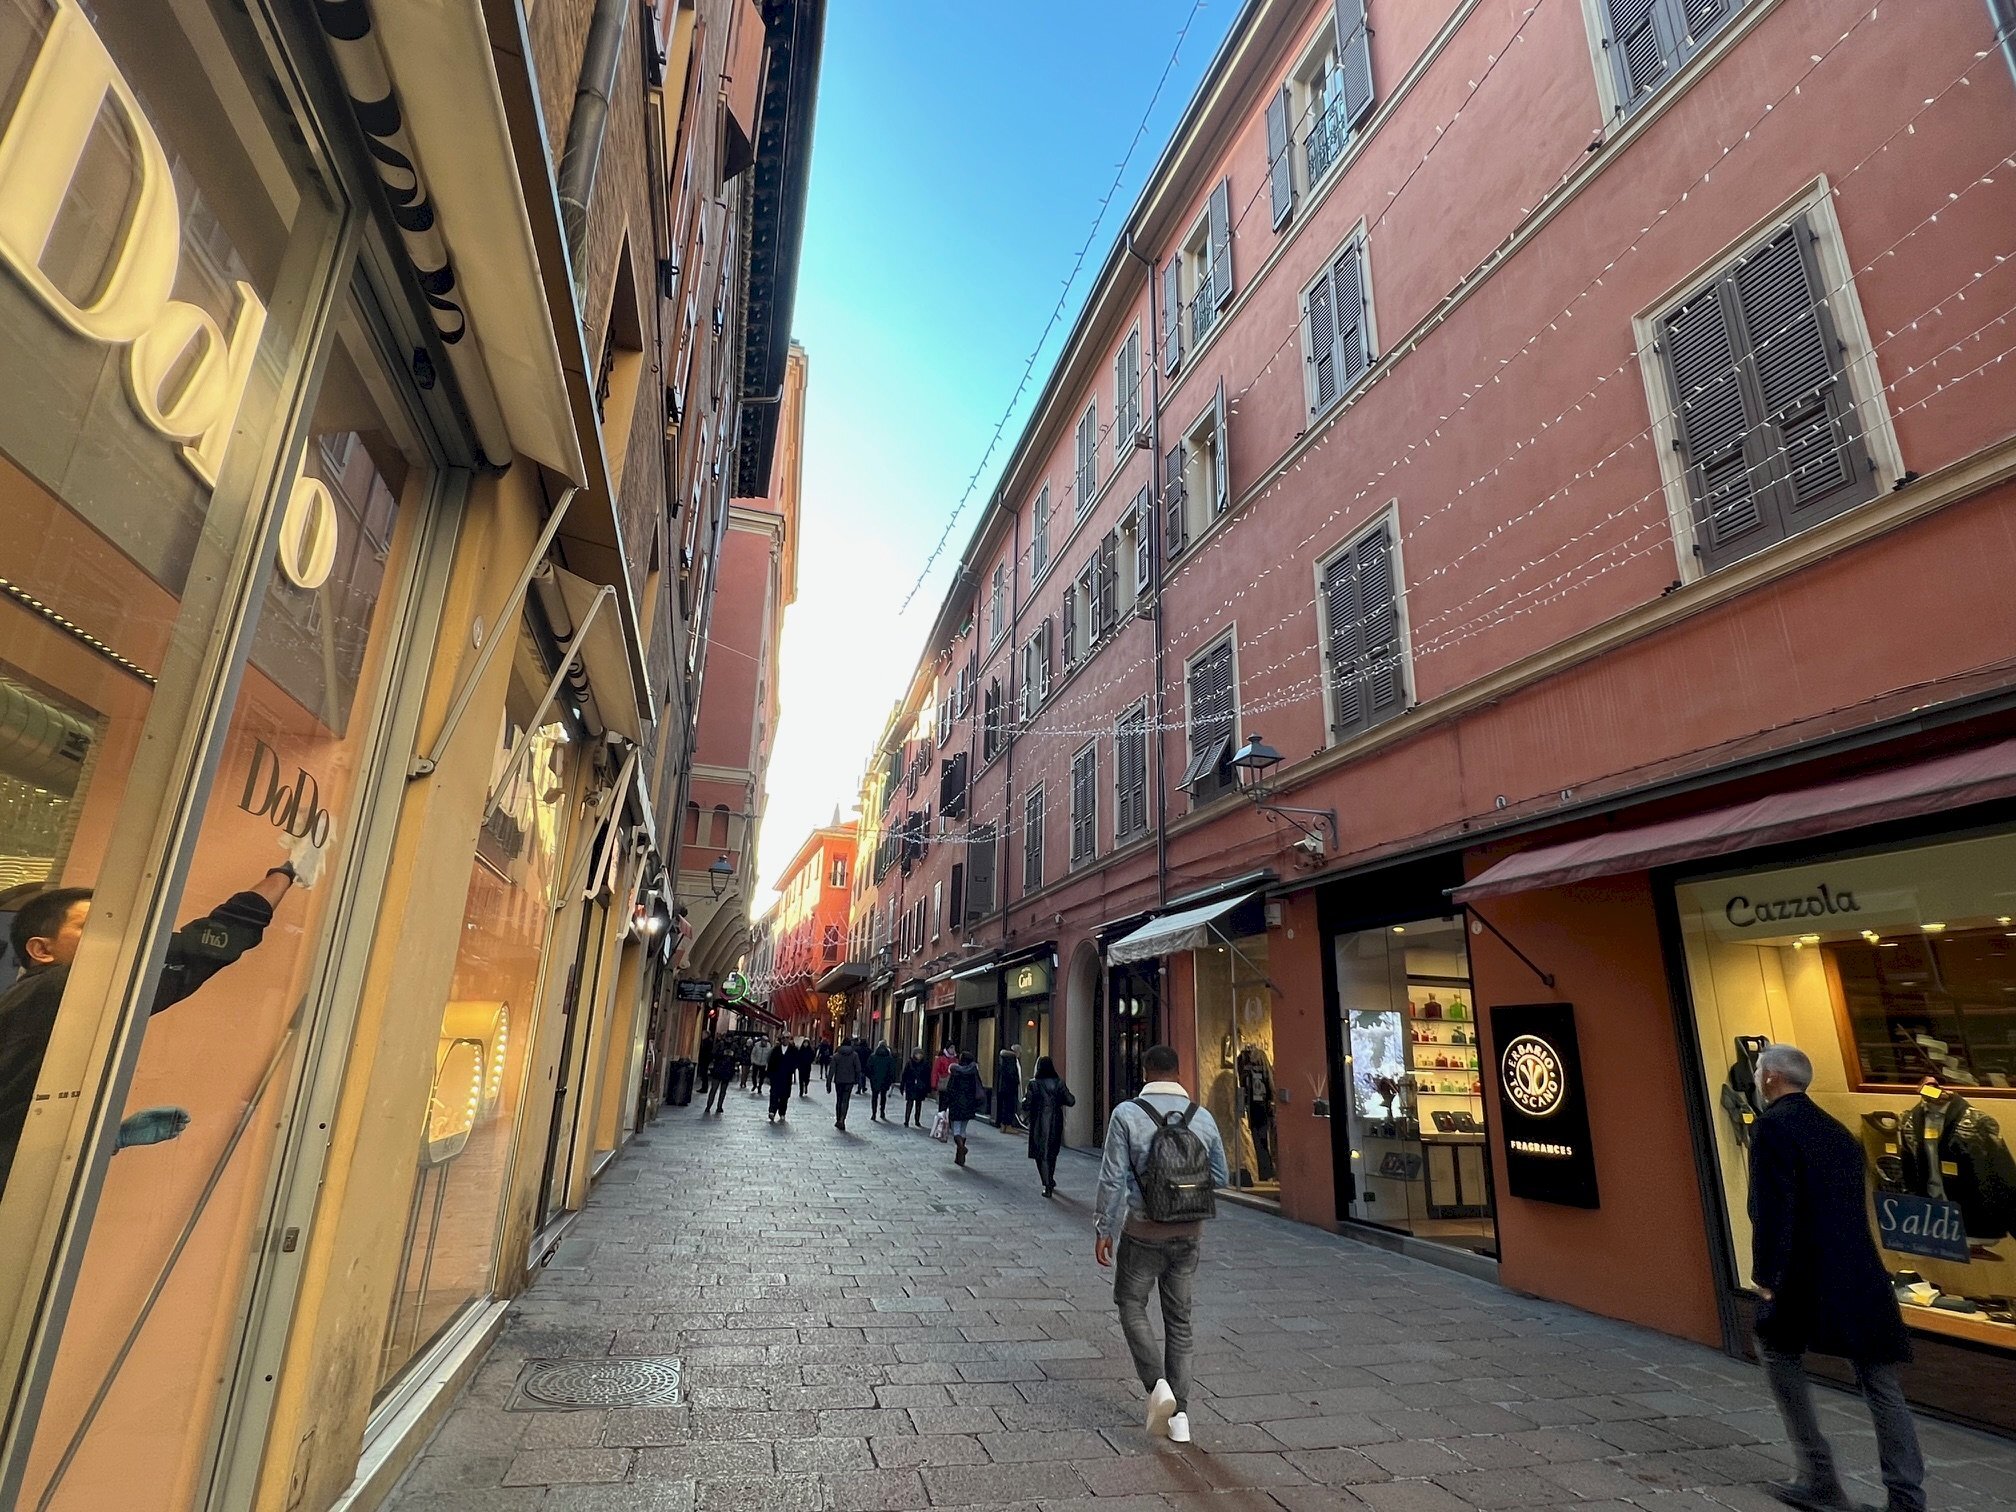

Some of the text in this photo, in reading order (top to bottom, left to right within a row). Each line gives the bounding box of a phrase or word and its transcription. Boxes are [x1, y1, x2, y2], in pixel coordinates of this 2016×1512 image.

[237, 736, 330, 849] DoDo
[1725, 883, 1861, 927] Cazzola
[1508, 1042, 1555, 1070] ERBARIO
[1510, 1078, 1558, 1108] TOSCANO
[1510, 1140, 1571, 1155] FRAGRANCES
[1880, 1198, 1961, 1241] Saldi
